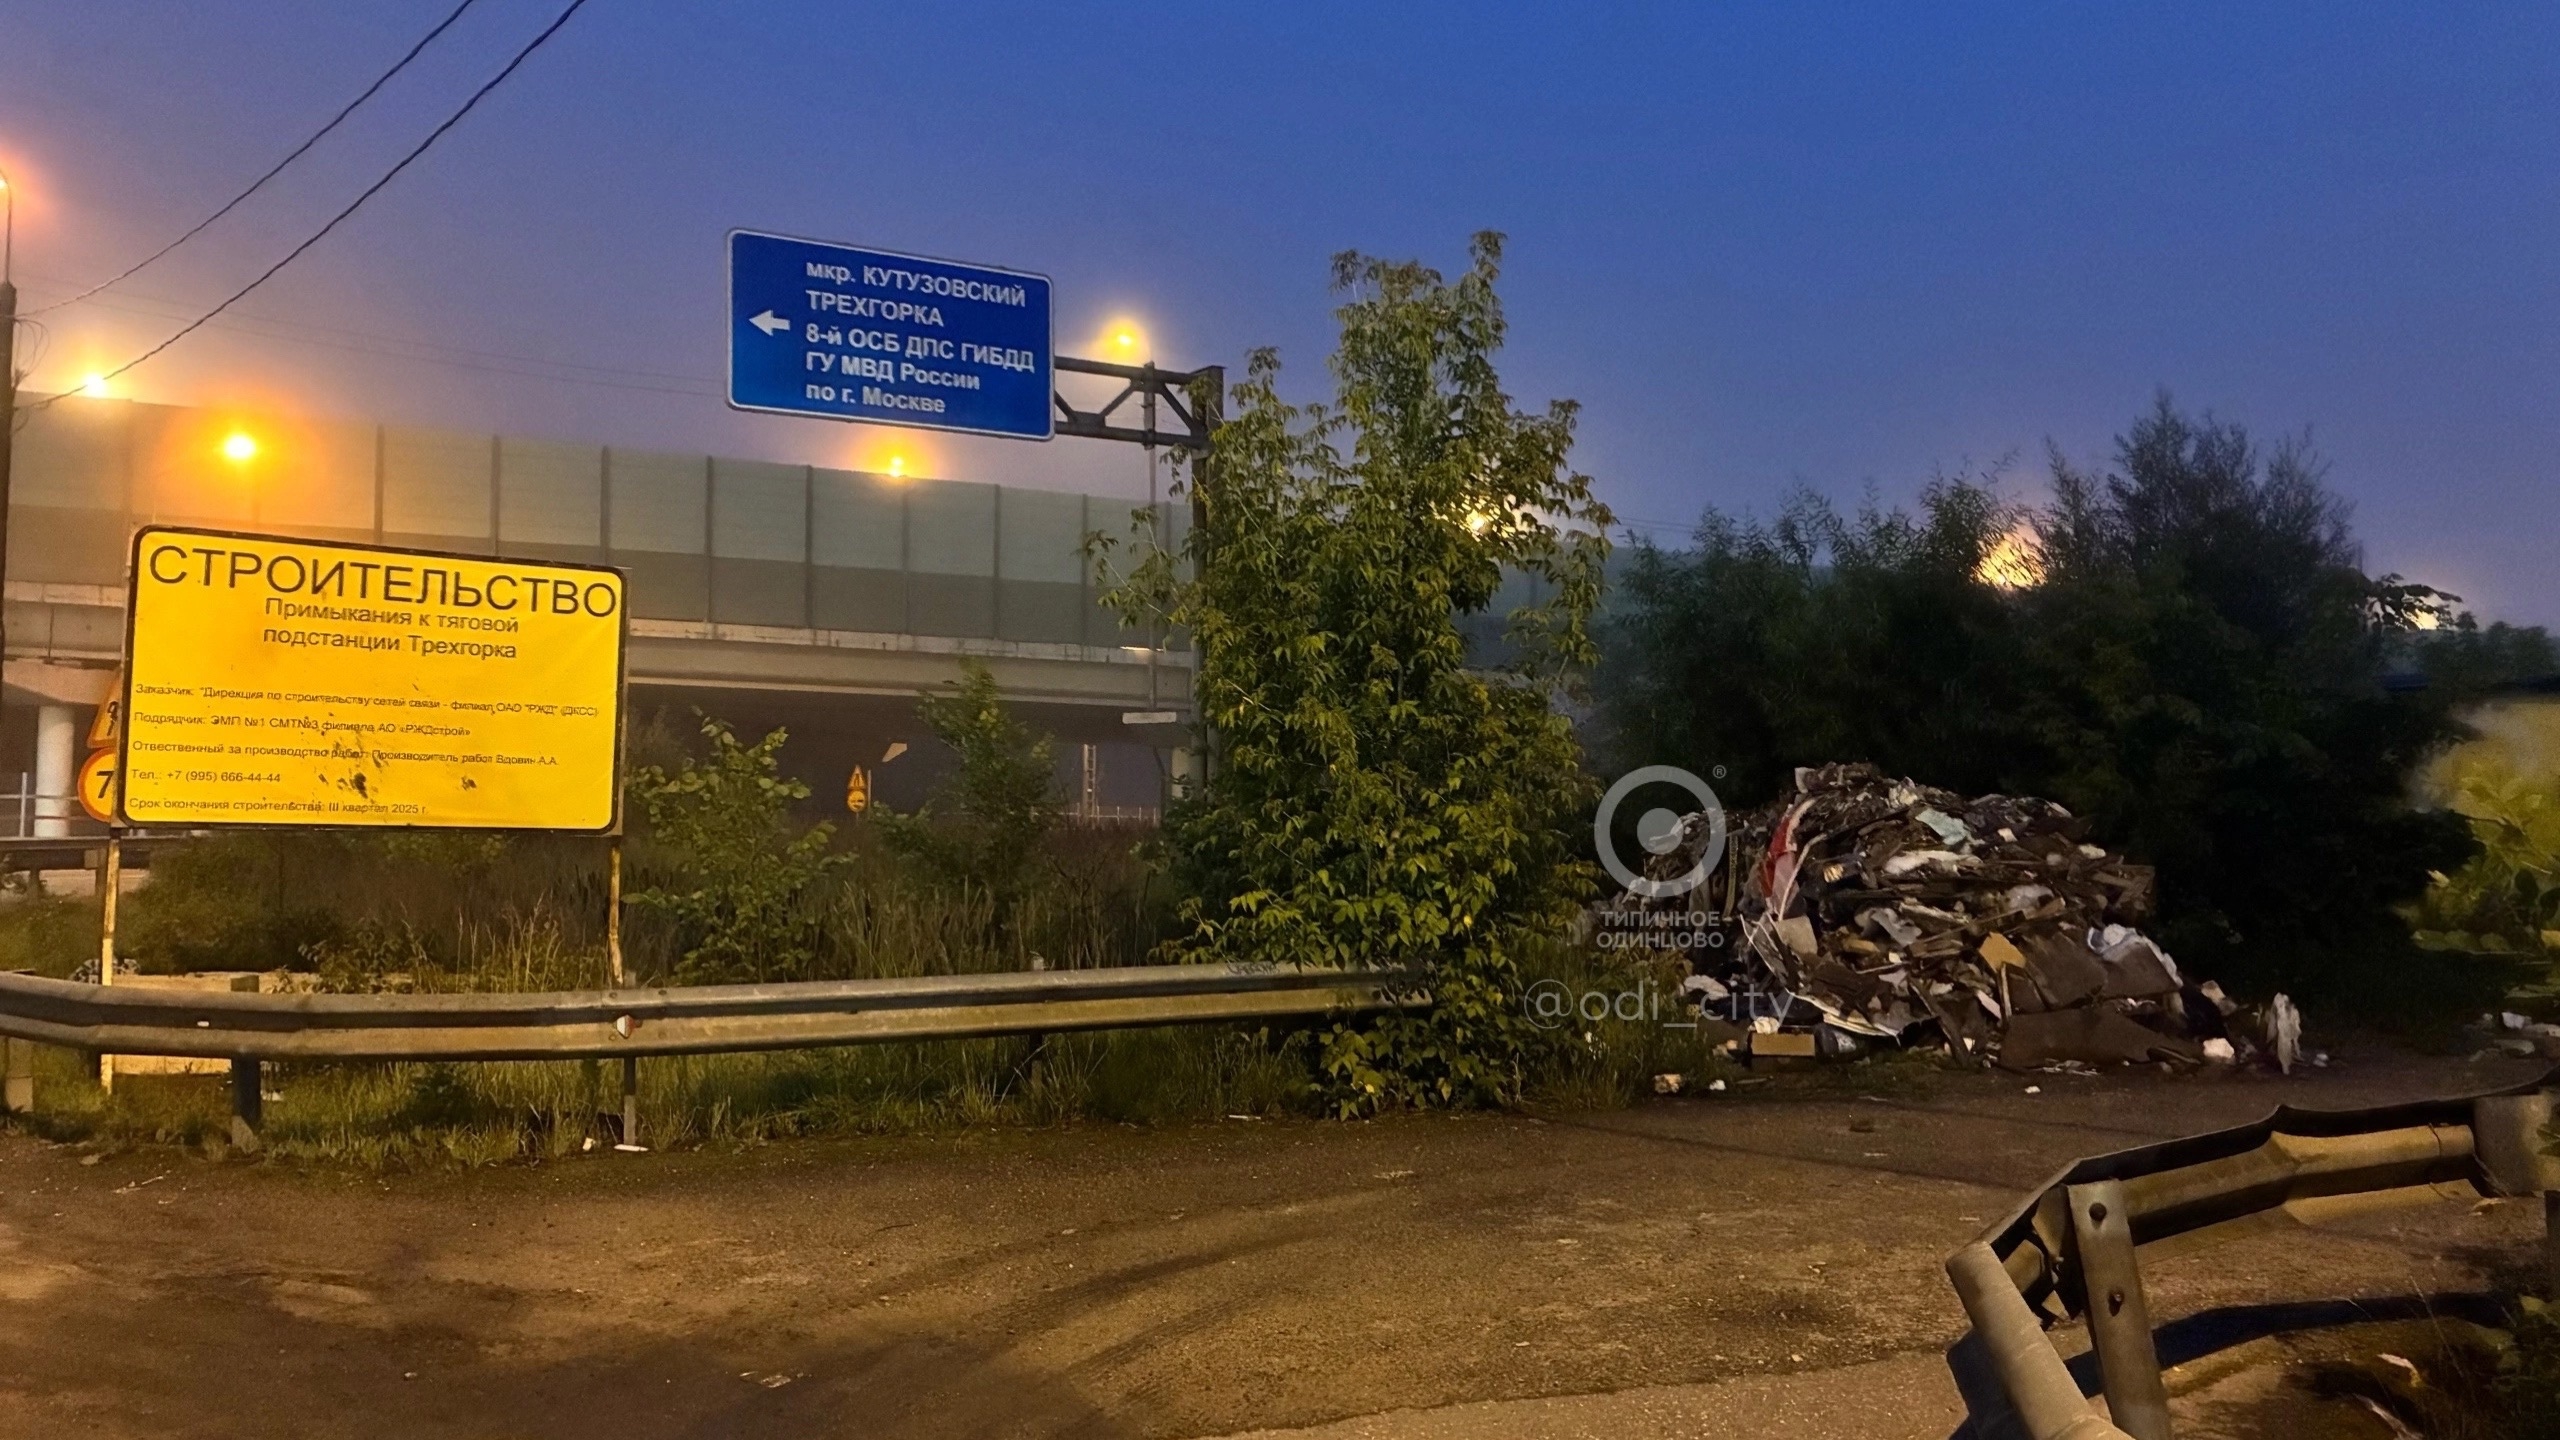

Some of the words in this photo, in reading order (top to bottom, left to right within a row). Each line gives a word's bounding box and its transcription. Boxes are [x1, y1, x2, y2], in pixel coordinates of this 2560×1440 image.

[806, 262, 856, 285] мкр.
[863, 265, 1026, 307] КУТУЗОВСКИЙ
[806, 289, 944, 327] ТРЕХГОРКА
[806, 323, 842, 345] 8-й
[848, 328, 900, 352] ОСБ
[905, 335, 954, 359] ДПС
[961, 343, 1035, 373] ГИБДД
[806, 352, 835, 372] ГУ
[841, 355, 895, 383] МВД
[900, 365, 980, 390] России
[806, 384, 836, 401] по
[841, 388, 856, 404] г.
[862, 385, 946, 413] Москве
[150, 545, 617, 618] СТРОИТЕЛЬСТВО
[265, 597, 412, 627] Примыкания
[419, 613, 431, 627] к
[437, 614, 519, 633] тяговой
[263, 629, 400, 652] подстанции
[408, 634, 517, 660] Трехгорка
[267, 691, 282, 701] по
[284, 692, 371, 706] строительству
[373, 697, 406, 707] сетей
[408, 699, 441, 708] связи
[496, 702, 522, 713] ОАО
[210, 715, 241, 726] ЭМП
[378, 723, 396, 733] АО
[132, 740, 225, 753] Отвественный
[228, 745, 242, 755] за
[245, 746, 328, 759] производство
[372, 749, 459, 763] Производитель
[461, 753, 493, 764] работ
[167, 770, 182, 780] +7
[185, 770, 218, 783] (995)
[220, 771, 281, 782] 666-44-44
[129, 797, 161, 809] Срок
[163, 800, 230, 810] окончания
[328, 802, 339, 812] III
[342, 804, 389, 814] квартал
[391, 803, 419, 814] 2025
